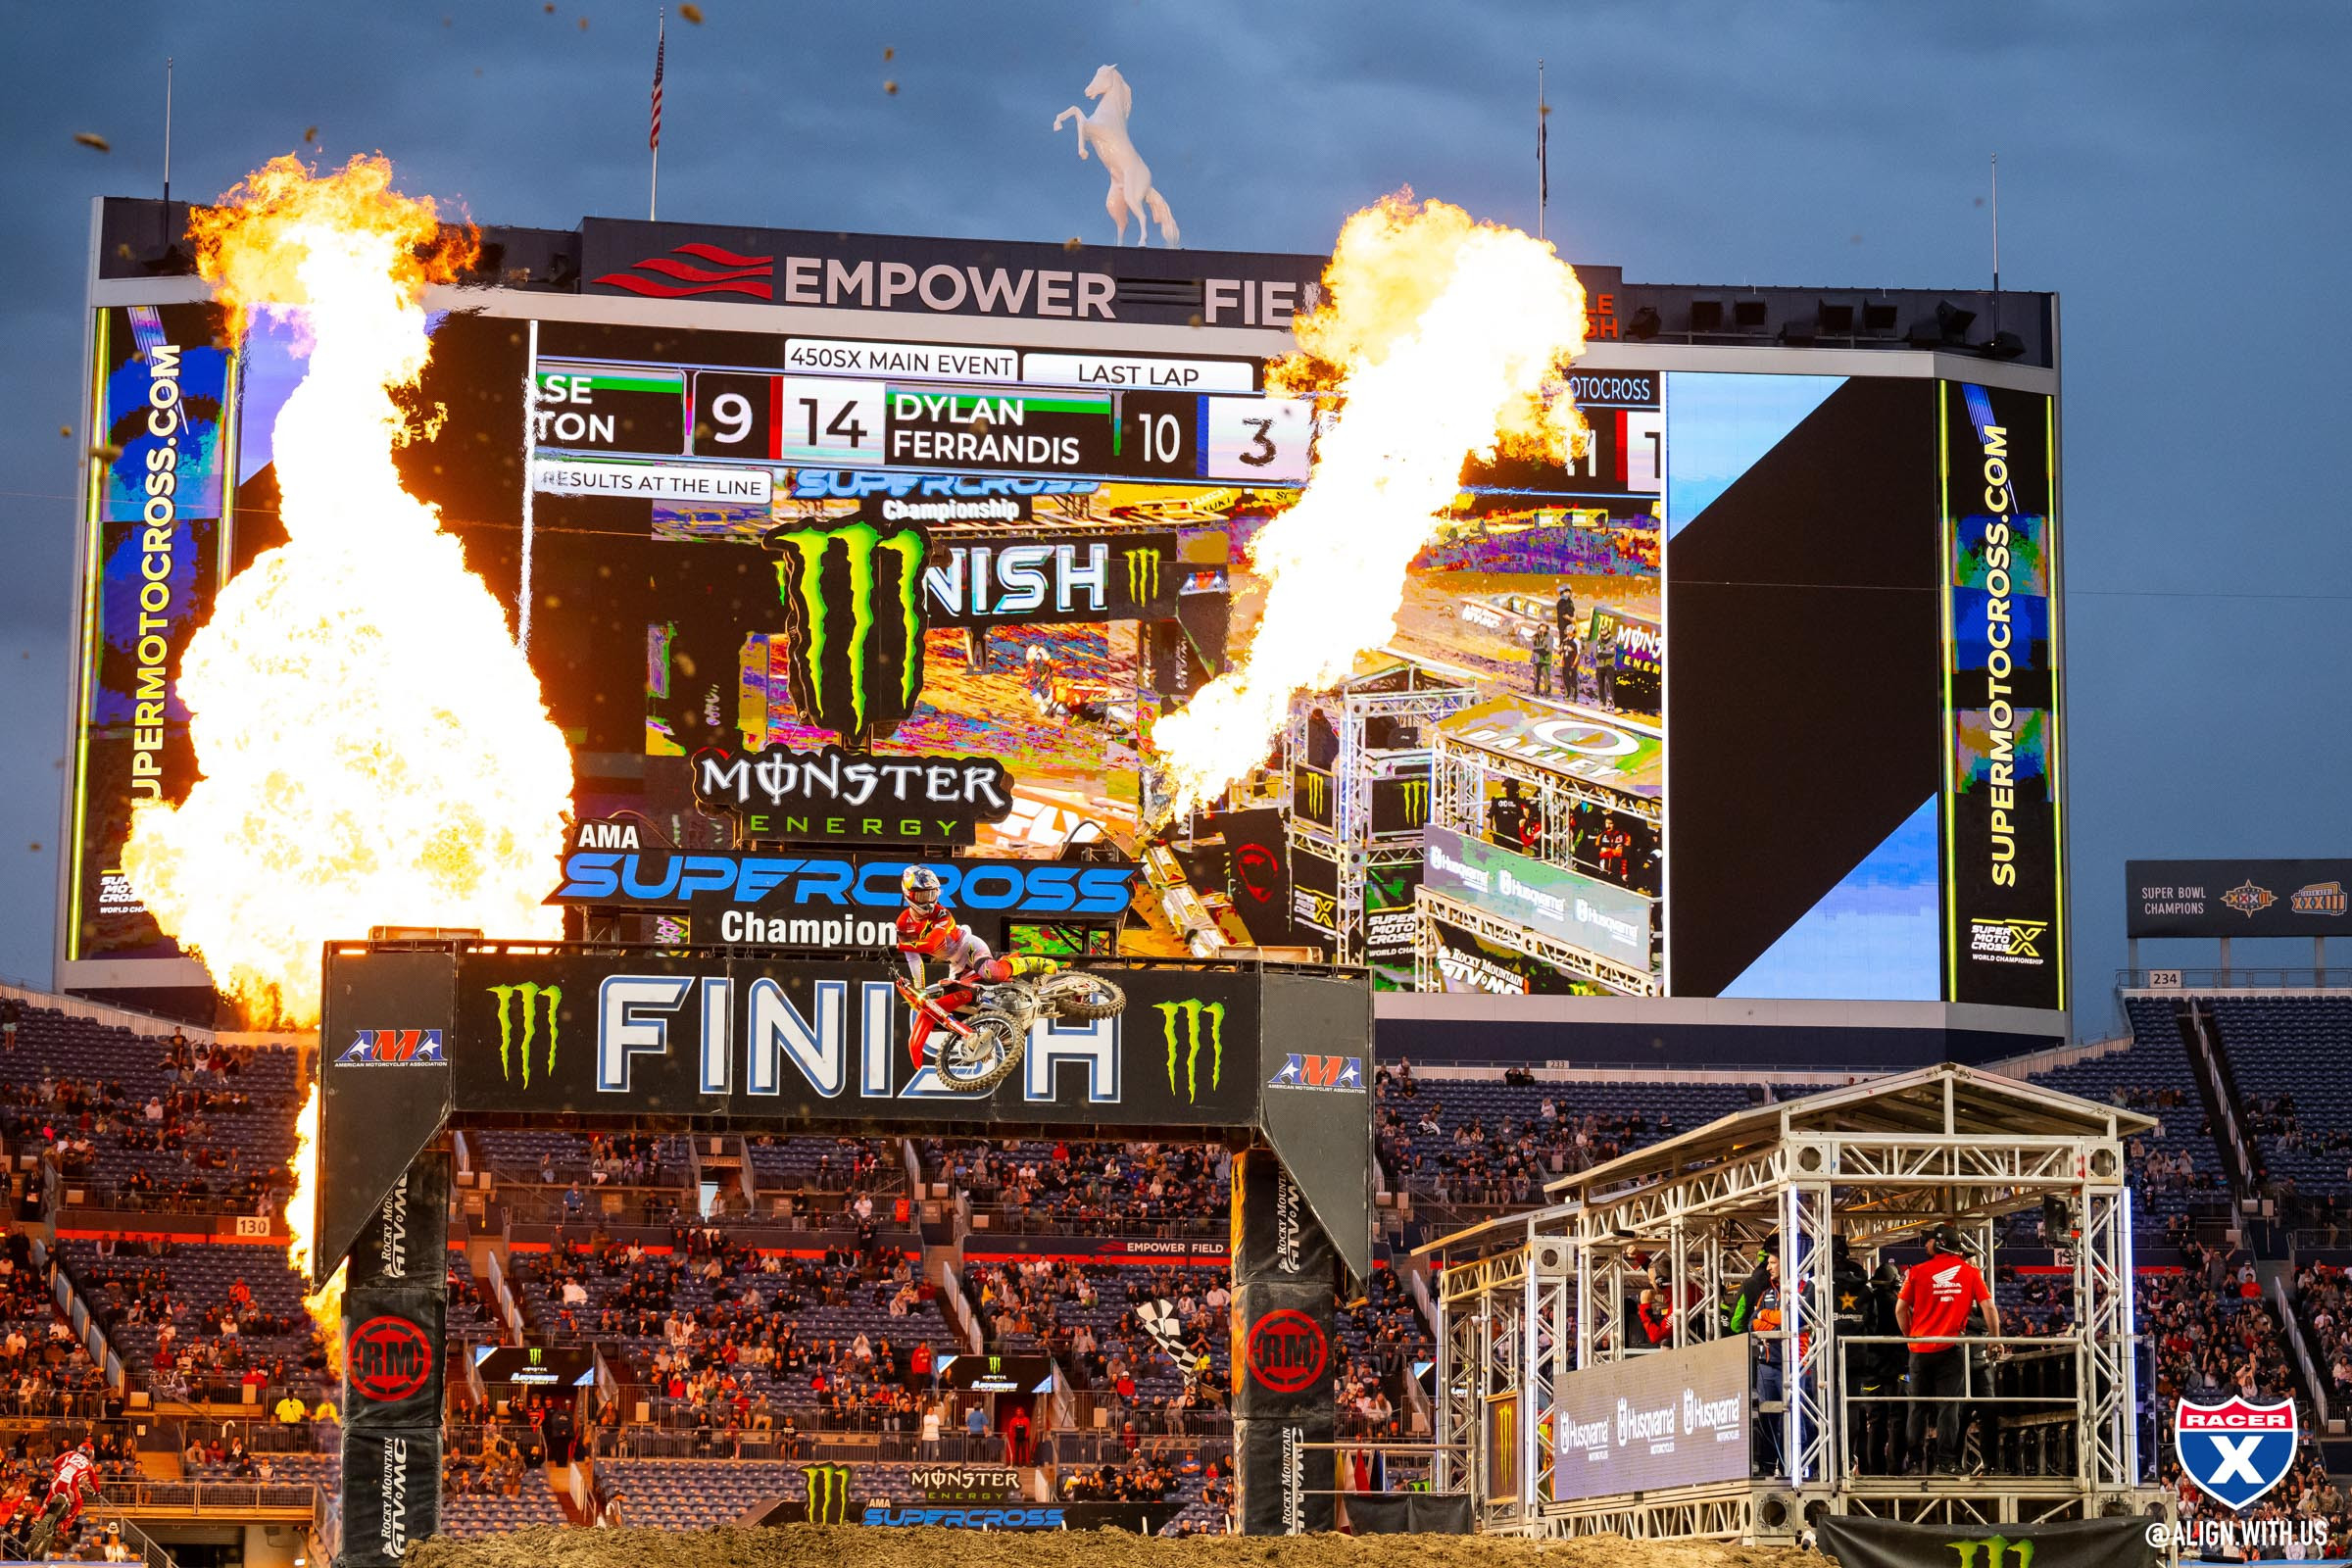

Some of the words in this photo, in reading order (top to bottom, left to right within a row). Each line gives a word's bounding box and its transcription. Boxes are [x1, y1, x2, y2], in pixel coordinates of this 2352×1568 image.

[785, 256, 1116, 319] EMPOWER
[1204, 278, 1320, 326] FIE
[1583, 294, 1614, 316] LE
[790, 347, 861, 368] 450SX
[869, 351, 929, 372] MAIN
[938, 355, 1013, 376] EVENT
[1078, 364, 1141, 385] LAST
[1150, 367, 1200, 387] LAP
[1571, 375, 1650, 401] OTOCROSS
[711, 393, 753, 444] 9
[799, 397, 867, 449] 14
[895, 393, 1025, 425] DYLAN
[894, 429, 1080, 466] FERRANDIS
[1138, 414, 1181, 464] 10
[1239, 417, 1277, 467] 3
[540, 469, 632, 491] RESULTS
[638, 475, 664, 492] AT
[669, 476, 710, 494] THE
[718, 478, 762, 496] LINE
[882, 498, 1020, 522] Championship
[131, 345, 181, 801] UPERMOTOCROSS.COM
[1984, 423, 2016, 887] SUPERMOTOCROSS.COM
[701, 753, 1005, 808] MONSTER
[577, 823, 640, 850] AMA
[750, 814, 958, 837] ENERGY
[557, 852, 1137, 913] SUPERCROSS
[2141, 887, 2174, 900] SUPER
[2178, 887, 2206, 900] BOWL
[1368, 913, 1416, 926] SUPER
[2144, 903, 2204, 915] CHAMPIONS
[721, 909, 972, 949] Champion
[1367, 933, 1415, 945] CROSS
[1372, 924, 1415, 935] MOTO
[1971, 924, 2012, 936] SUPER
[1974, 934, 2010, 944] MOTO
[1971, 942, 2011, 953] CROSS
[1972, 953, 1995, 961] WORLD
[1995, 956, 2044, 965] CHAMPIONSHIP
[1452, 948, 1482, 969] ROCKY
[1482, 958, 1524, 987] MOUNTAIN
[2153, 973, 2178, 985] 234
[333, 1028, 449, 1062] AMA
[1267, 1053, 1367, 1089] AMA
[239, 1220, 267, 1234] 130
[381, 1224, 392, 1261] ROCKY
[1277, 1219, 1287, 1254] ROCKY
[1127, 1243, 1186, 1252] EMPOWER
[1192, 1243, 1224, 1253] FIELD
[362, 1341, 415, 1378] RM
[1260, 1334, 1310, 1369] RM
[1627, 1406, 1676, 1442] Husqvarna
[1694, 1396, 1740, 1431] Husqvarna
[1569, 1419, 1608, 1450] Husqvarna
[382, 1438, 393, 1499] MOUNTAIN
[1282, 1427, 1292, 1488] MOUNTAIN
[911, 1469, 1020, 1489] MONSTER
[868, 1498, 892, 1508] AMA
[928, 1492, 1004, 1500] ENERGY
[1282, 1489, 1292, 1525] ROCKY
[381, 1501, 392, 1539] ROCKY
[862, 1509, 1065, 1527] SUPERCROSS
